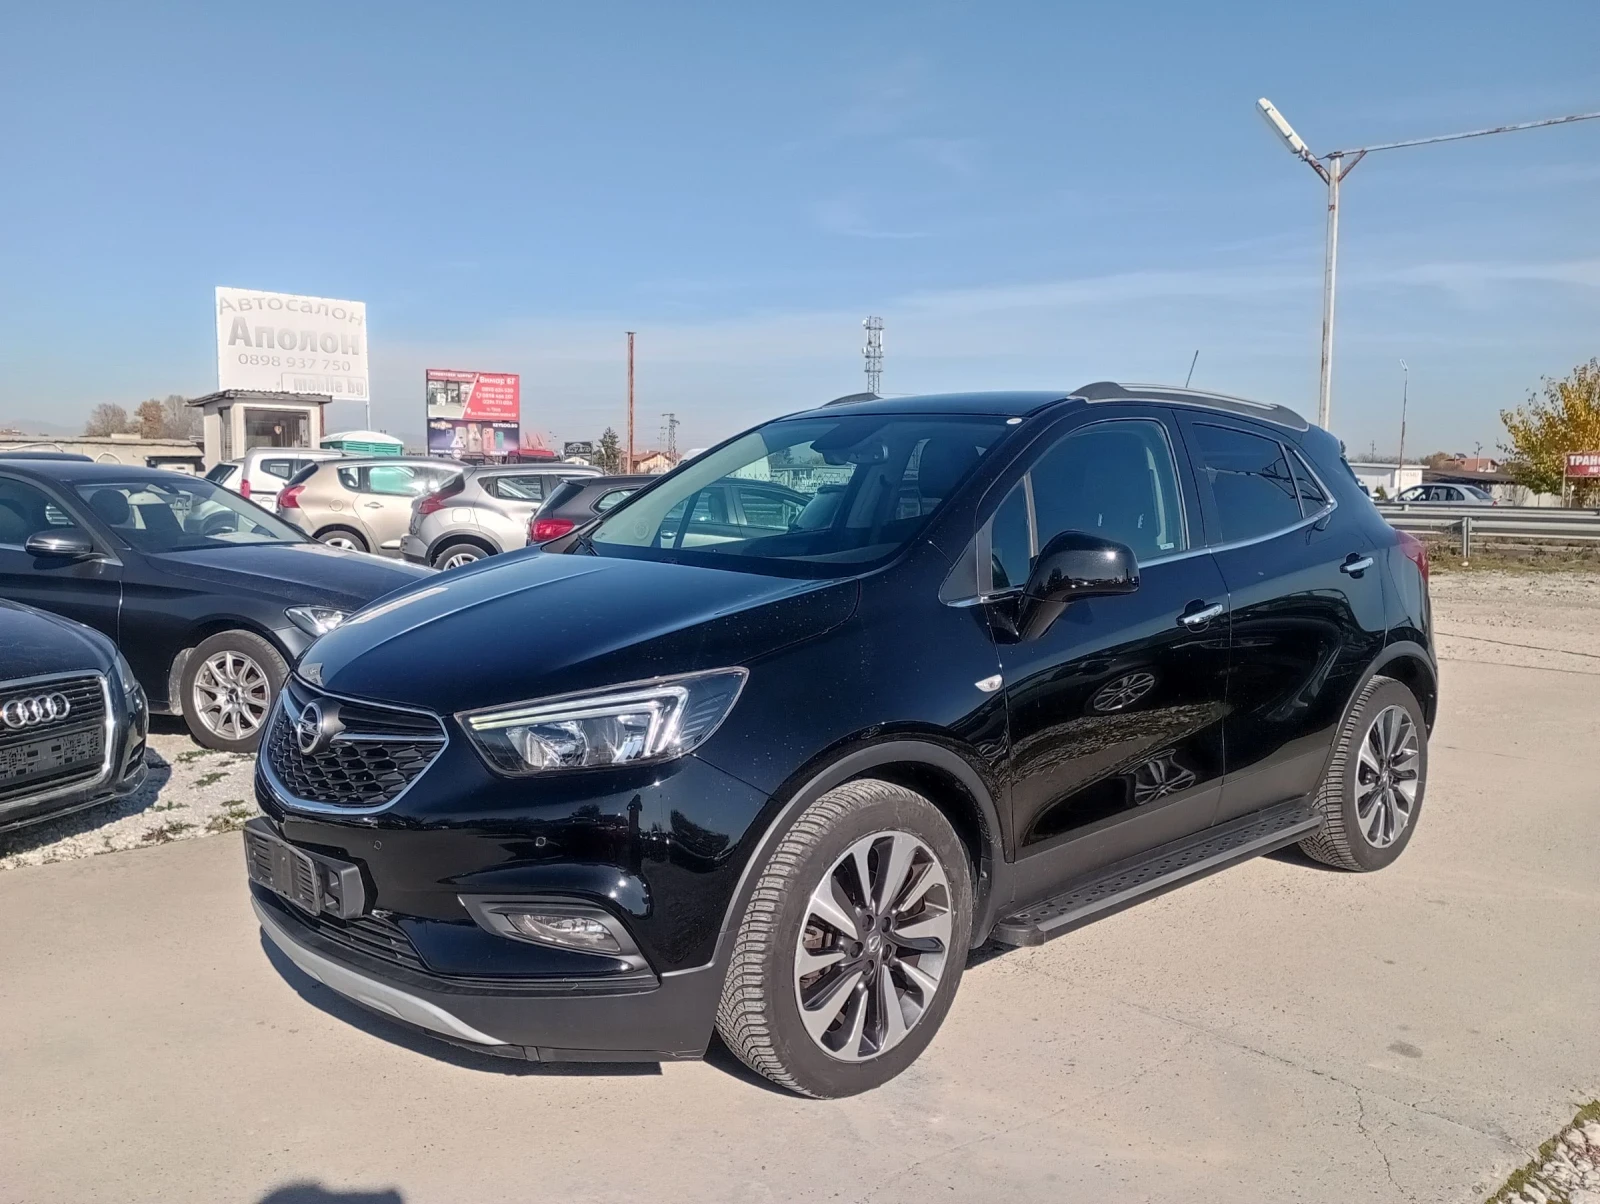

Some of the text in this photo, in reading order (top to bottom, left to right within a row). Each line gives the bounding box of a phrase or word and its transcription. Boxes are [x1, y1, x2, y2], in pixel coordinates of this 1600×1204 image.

[218, 297, 364, 327] Автосалон
[228, 316, 360, 356] Аполон
[238, 353, 351, 372] 0898 937 750
[1569, 455, 1600, 466] ТРАН
